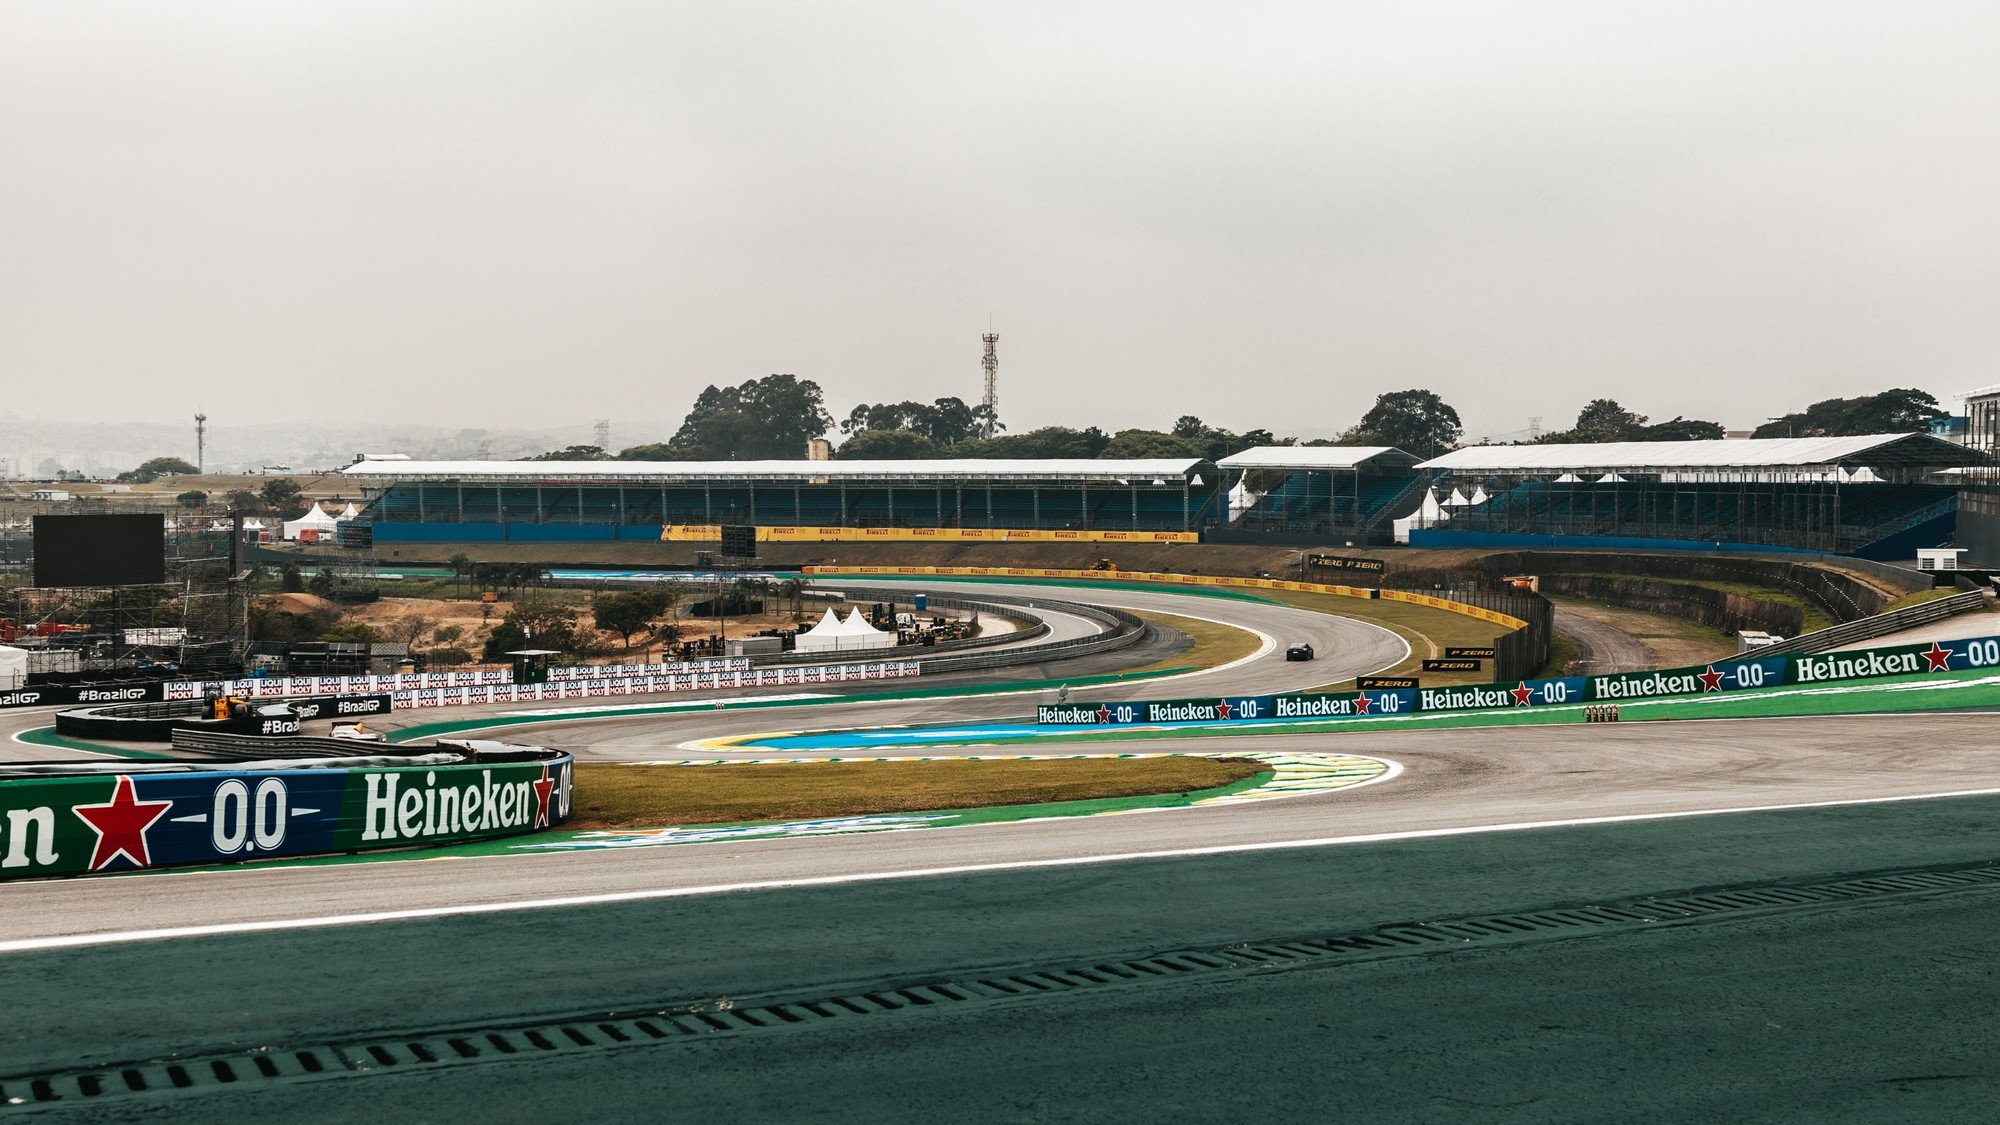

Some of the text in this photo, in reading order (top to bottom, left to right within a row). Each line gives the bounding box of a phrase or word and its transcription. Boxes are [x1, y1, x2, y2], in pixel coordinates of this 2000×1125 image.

[688, 661, 704, 669] LIQUI
[710, 660, 725, 668] LIQUI
[1795, 640, 2000, 682] Heineken 0.0
[576, 667, 593, 675] LIQUI
[600, 666, 617, 674] LIQUI
[645, 664, 661, 672] LIQUI
[805, 667, 820, 675] LIQUI
[825, 666, 840, 674] LIQUI
[846, 665, 861, 673] LIQUI
[866, 664, 880, 672] LIQUI
[456, 672, 475, 680] LIQUI
[482, 671, 501, 680] LIQUI
[719, 672, 735, 680] LIQUI
[741, 671, 757, 679] LIQUI
[762, 670, 778, 678] LIQUI
[784, 668, 799, 677] LIQUI
[846, 672, 861, 680] MOLY
[865, 671, 880, 679] MOLY
[885, 670, 900, 678] MOLY
[319, 677, 341, 685] LIQUI
[349, 675, 370, 684] LIQUI
[377, 675, 395, 683] LIQUI
[401, 674, 421, 682] LIQUI
[429, 673, 448, 681] LIQUI
[631, 677, 648, 685] LIQUI
[654, 676, 669, 684] LIQUI
[676, 675, 692, 683] LIQUI
[698, 673, 713, 682] LIQUI
[762, 677, 778, 685] MOLY
[784, 676, 800, 684] MOLY
[805, 675, 820, 683] MOLY
[825, 673, 841, 681] MOLY
[1594, 663, 1763, 699] Heineken 0.0
[233, 680, 253, 689] LIQUI
[260, 679, 282, 687] LIQUI
[291, 678, 311, 686] LIQUI
[401, 681, 421, 690] MOLY
[428, 680, 448, 689] MOLY
[565, 682, 582, 690] LIQUI
[588, 680, 605, 688] LIQUI
[610, 679, 625, 687] LIQUI
[676, 682, 692, 690] MOLY
[698, 681, 714, 689] MOLY
[719, 680, 735, 688] MOLY
[741, 678, 757, 687] MOLY
[169, 683, 193, 691] LIQUI
[260, 686, 283, 695] MOLY
[291, 685, 311, 694] MOLY
[319, 684, 341, 693] MOLY
[349, 683, 370, 692] MOLY
[377, 682, 395, 691] MOLY
[494, 686, 511, 694] LIQUI
[518, 684, 535, 693] LIQUI
[543, 683, 559, 691] LIQUI
[610, 686, 626, 695] MOLY
[631, 685, 648, 693] MOLY
[653, 683, 670, 692] MOLY
[78, 688, 146, 701] #BrazilGP
[169, 691, 193, 699] MOLY
[394, 691, 412, 700] LIQUI
[419, 690, 437, 699] LIQUI
[444, 689, 462, 697] LIQUI
[469, 687, 487, 696] LIQUI
[542, 691, 560, 699] MOLY
[565, 689, 582, 698] MOLY
[588, 688, 605, 696] MOLY
[1420, 681, 1566, 710] Heineken 0.0
[469, 695, 488, 704] MOLY
[493, 693, 512, 702] MOLY
[518, 692, 536, 701] MOLY
[394, 700, 412, 709] MOLY
[419, 698, 438, 707] MOLY
[444, 697, 462, 706] MOLY
[1276, 693, 1398, 717] Heineken 0.0
[338, 699, 380, 713] #BrazilGP
[1038, 705, 1133, 723] Heineken 0.0
[1149, 700, 1257, 722] Heineken 0.0
[361, 770, 530, 841] Heineken
[211, 776, 288, 855] 0.0
